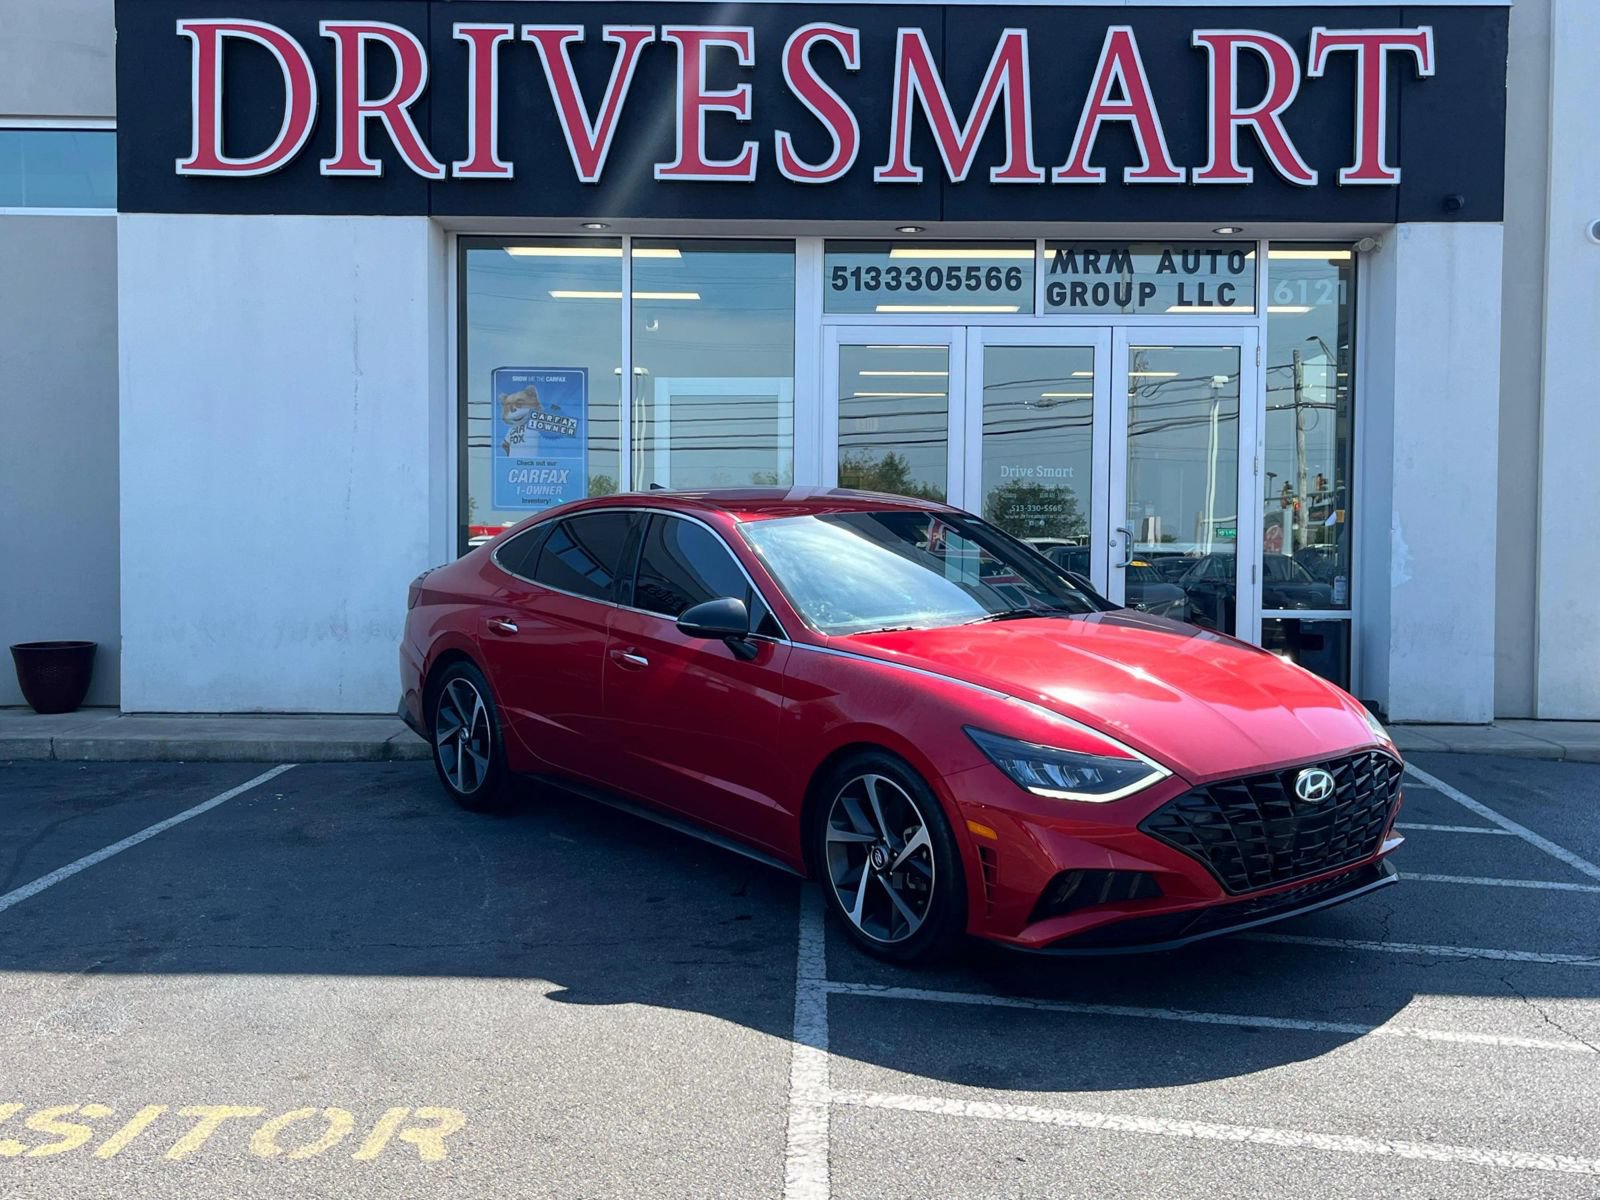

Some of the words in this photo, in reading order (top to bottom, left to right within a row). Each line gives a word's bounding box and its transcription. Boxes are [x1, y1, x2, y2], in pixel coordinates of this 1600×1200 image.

[174, 17, 1436, 187] DRIVESMART
[1050, 249, 1134, 275] MRM
[1158, 249, 1246, 275] AUTO
[831, 265, 1023, 293] 5133305566
[1273, 279, 1347, 304] 6121
[1045, 282, 1157, 307] GROUP
[1177, 283, 1236, 306] LLC
[530, 411, 577, 429] CARFAX
[508, 469, 570, 484] CARFAX
[1001, 465, 1033, 478] Drive
[1036, 465, 1074, 478] Smart
[516, 484, 563, 496] 1-OWNER
